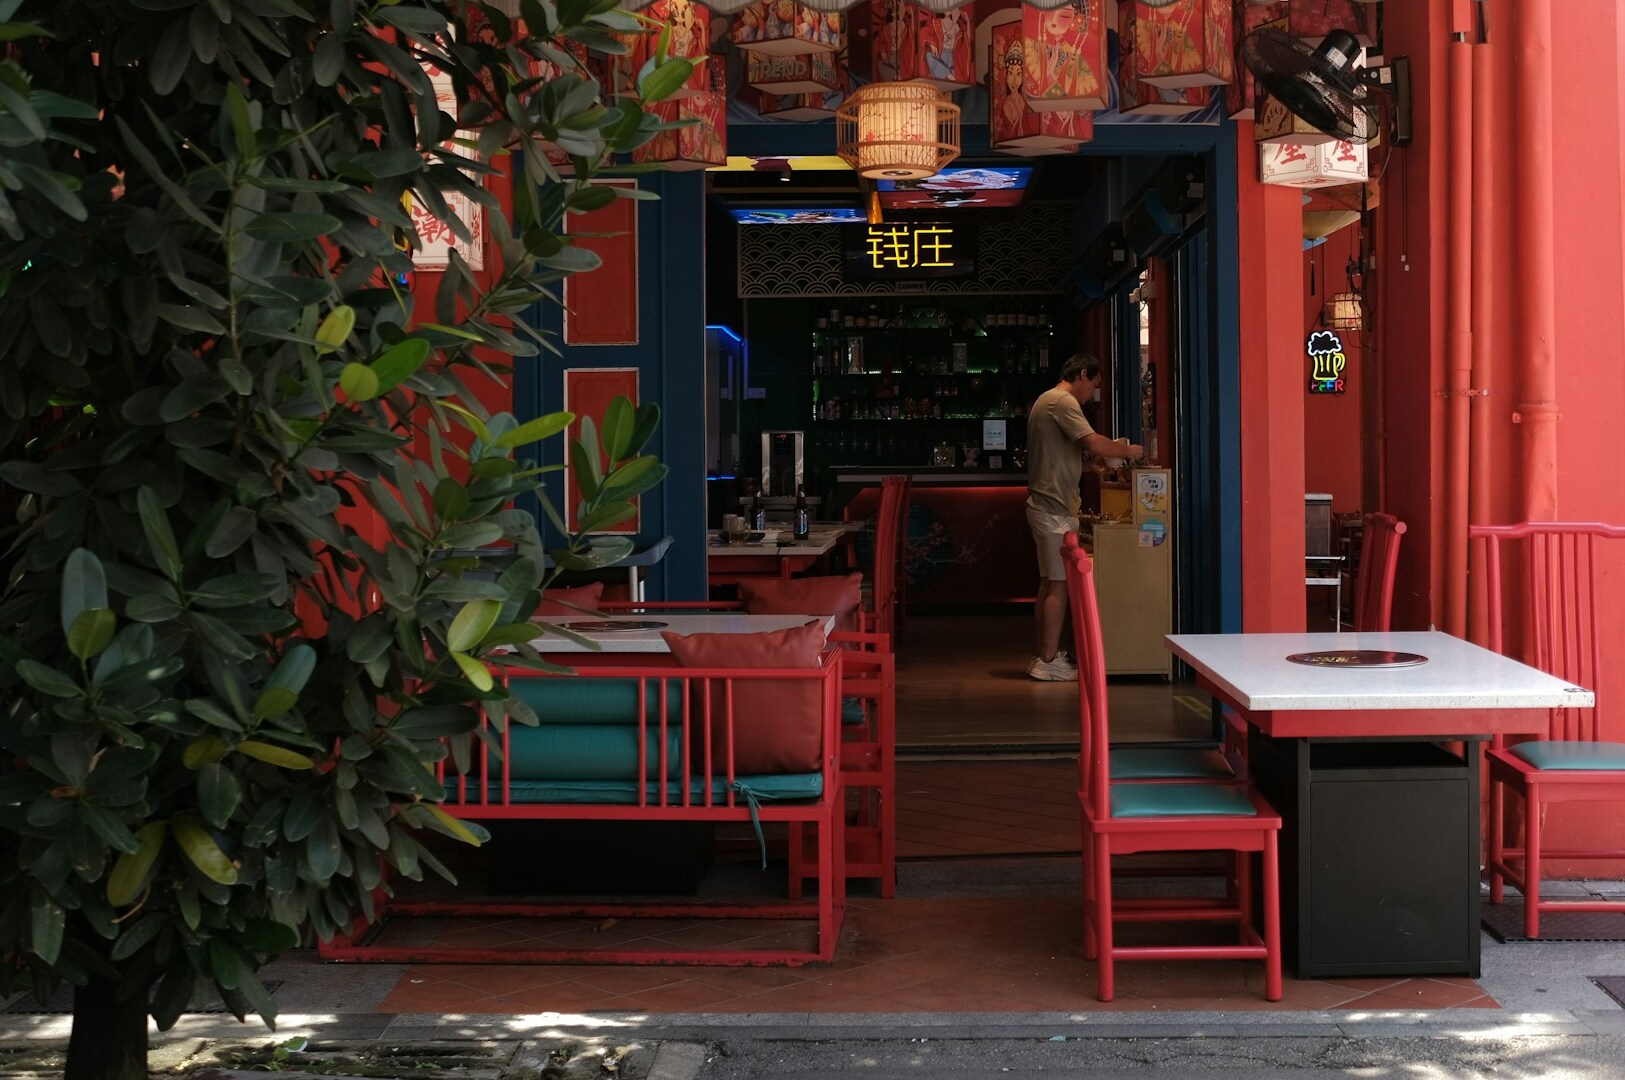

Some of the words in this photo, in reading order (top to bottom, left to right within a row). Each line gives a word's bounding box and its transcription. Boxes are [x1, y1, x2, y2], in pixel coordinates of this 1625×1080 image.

[748, 60, 807, 81] TREND
[866, 225, 954, 268] 钱庄
[1311, 379, 1344, 392] BEER
